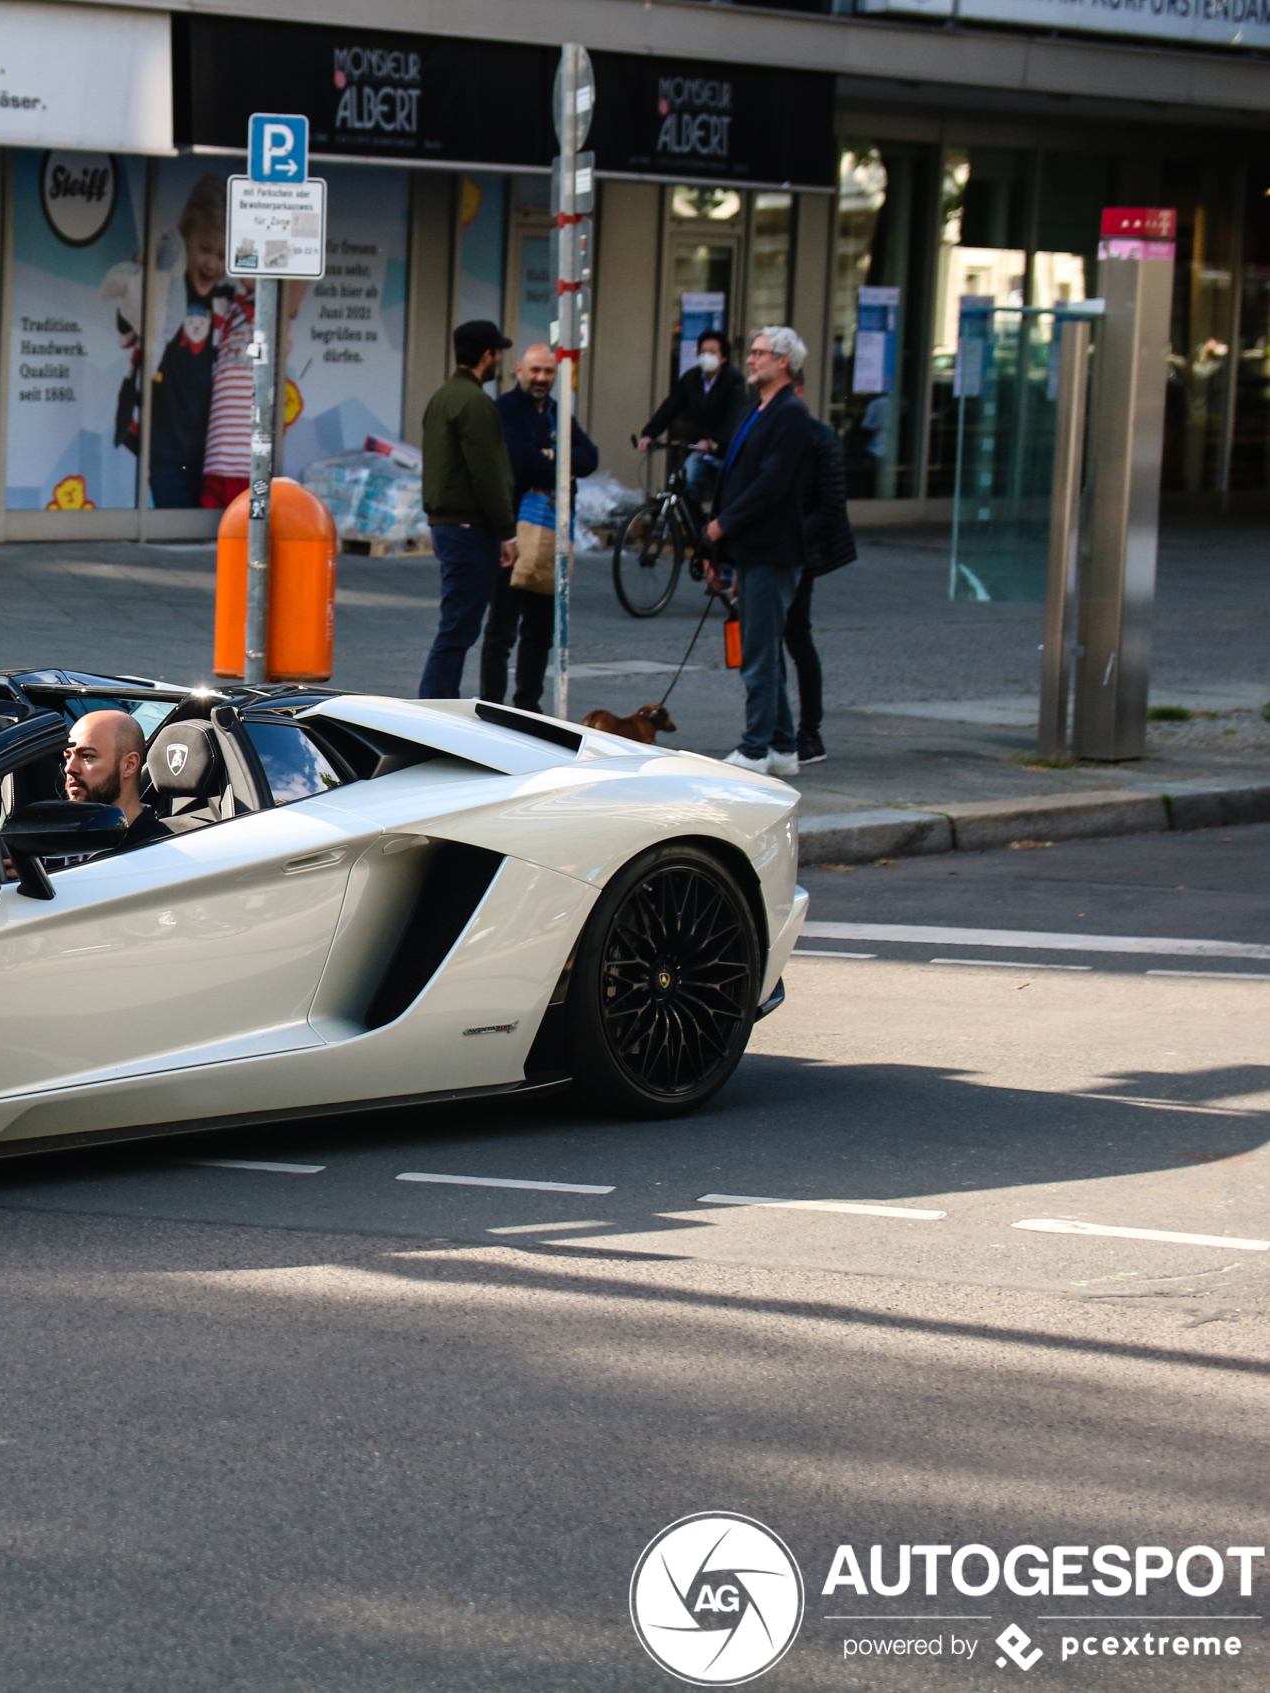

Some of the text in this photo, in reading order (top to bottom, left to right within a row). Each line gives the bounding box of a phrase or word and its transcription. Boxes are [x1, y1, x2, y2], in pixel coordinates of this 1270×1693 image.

[333, 47, 422, 81] MONSIEUR
[335, 86, 422, 133] ALBERT
[657, 113, 731, 157] ALBERT
[263, 124, 294, 175] P
[50, 164, 110, 203] Steiff
[243, 187, 310, 198] mit Parkschein oder
[271, 215, 291, 226] Zone
[341, 240, 377, 255] freuen
[313, 282, 378, 297] dich hier ab
[318, 305, 371, 319] Juni 2021
[21, 317, 82, 333] Tradition.
[310, 326, 378, 344] begrüßen zu
[20, 341, 88, 356] Handwerk.
[322, 348, 363, 363] dürfen.
[19, 363, 69, 379] Qualität
[19, 388, 76, 401] seit 1880.
